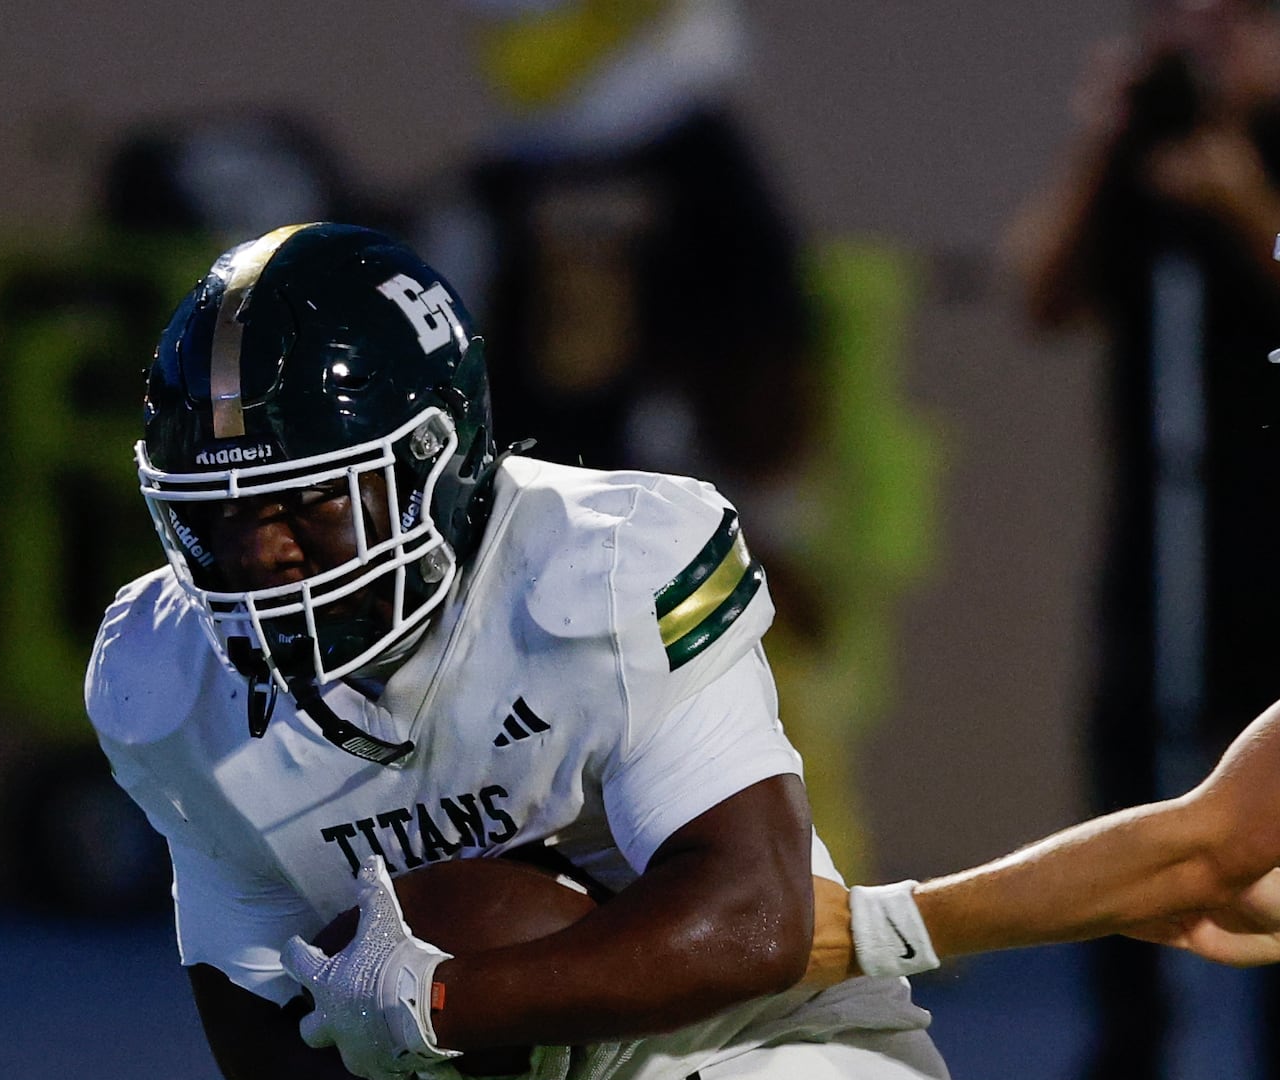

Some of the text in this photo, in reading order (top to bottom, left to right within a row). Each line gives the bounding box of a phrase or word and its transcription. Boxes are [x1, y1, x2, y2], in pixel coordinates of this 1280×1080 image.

[376, 273, 470, 355] BT
[168, 507, 214, 568] Riddell
[401, 489, 424, 533] dell
[321, 784, 519, 879] TITANS
